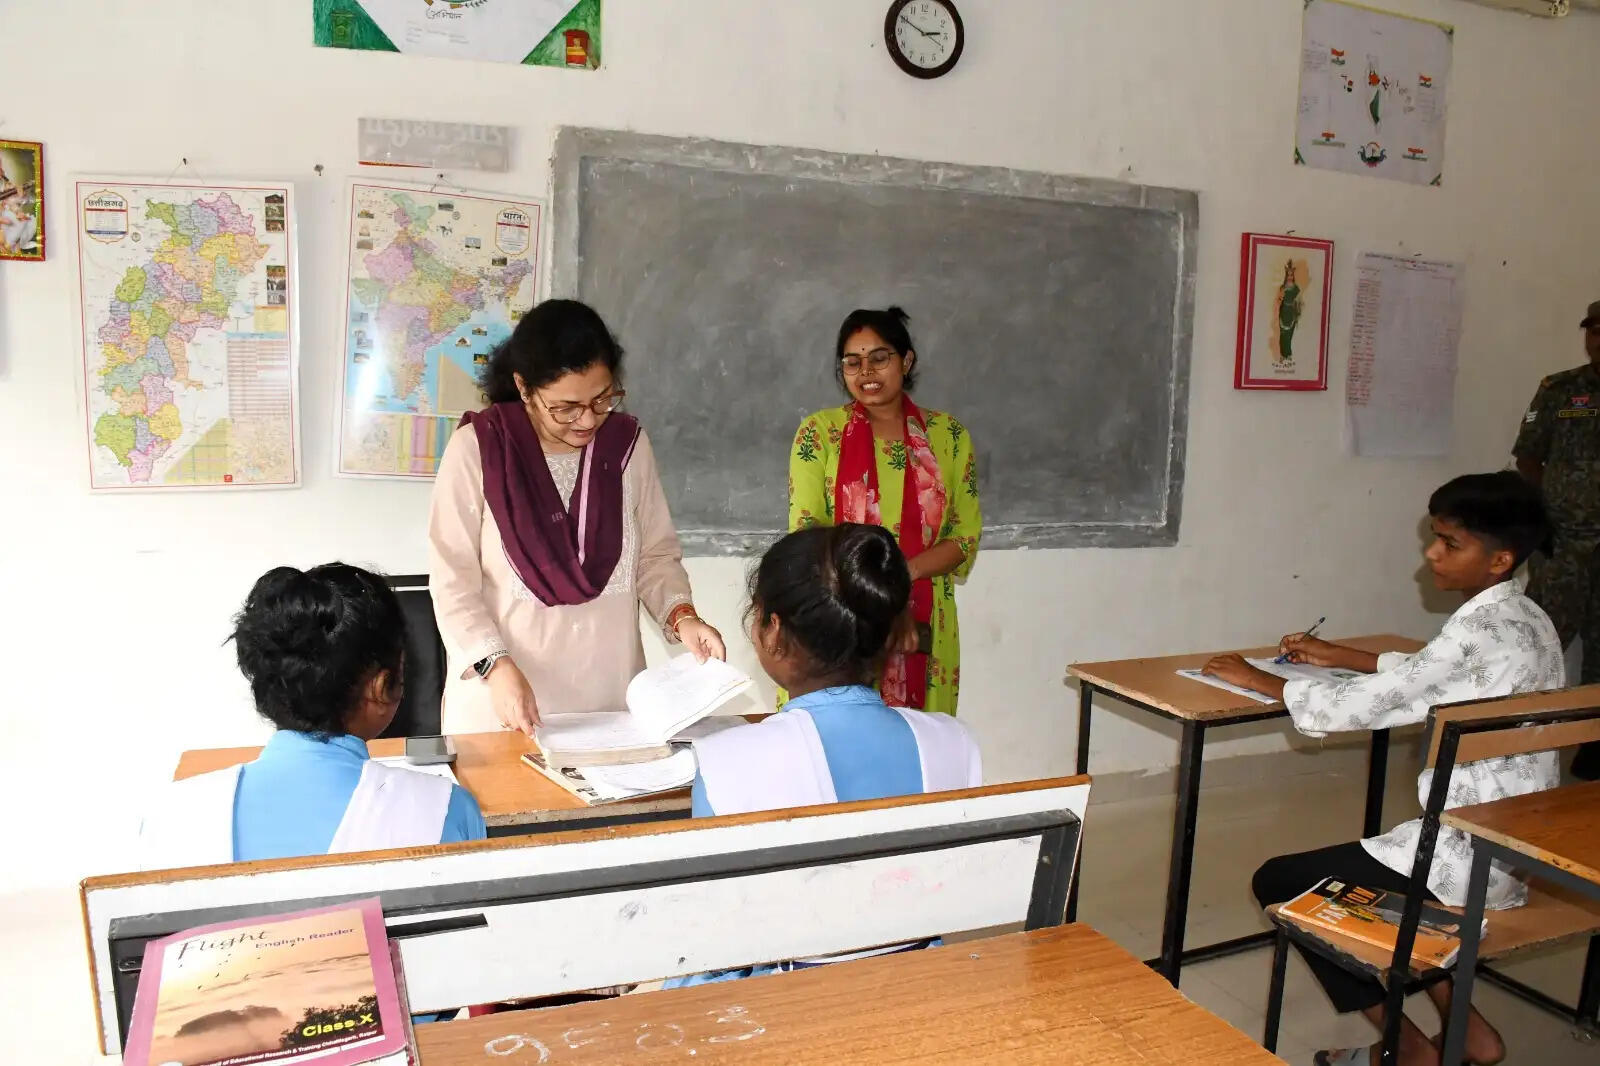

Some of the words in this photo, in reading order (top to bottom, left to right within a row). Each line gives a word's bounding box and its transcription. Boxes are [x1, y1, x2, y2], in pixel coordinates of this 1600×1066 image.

[921, 4, 929, 13] 12
[177, 930, 271, 960] Flight
[255, 936, 305, 949] English
[309, 928, 355, 941] Reader
[302, 1019, 356, 1037] Class
[360, 1012, 374, 1025] X
[229, 1054, 264, 1064] Educational
[264, 1049, 292, 1058] Research
[298, 1043, 321, 1053] Training
[359, 1029, 378, 1038] Raipur
